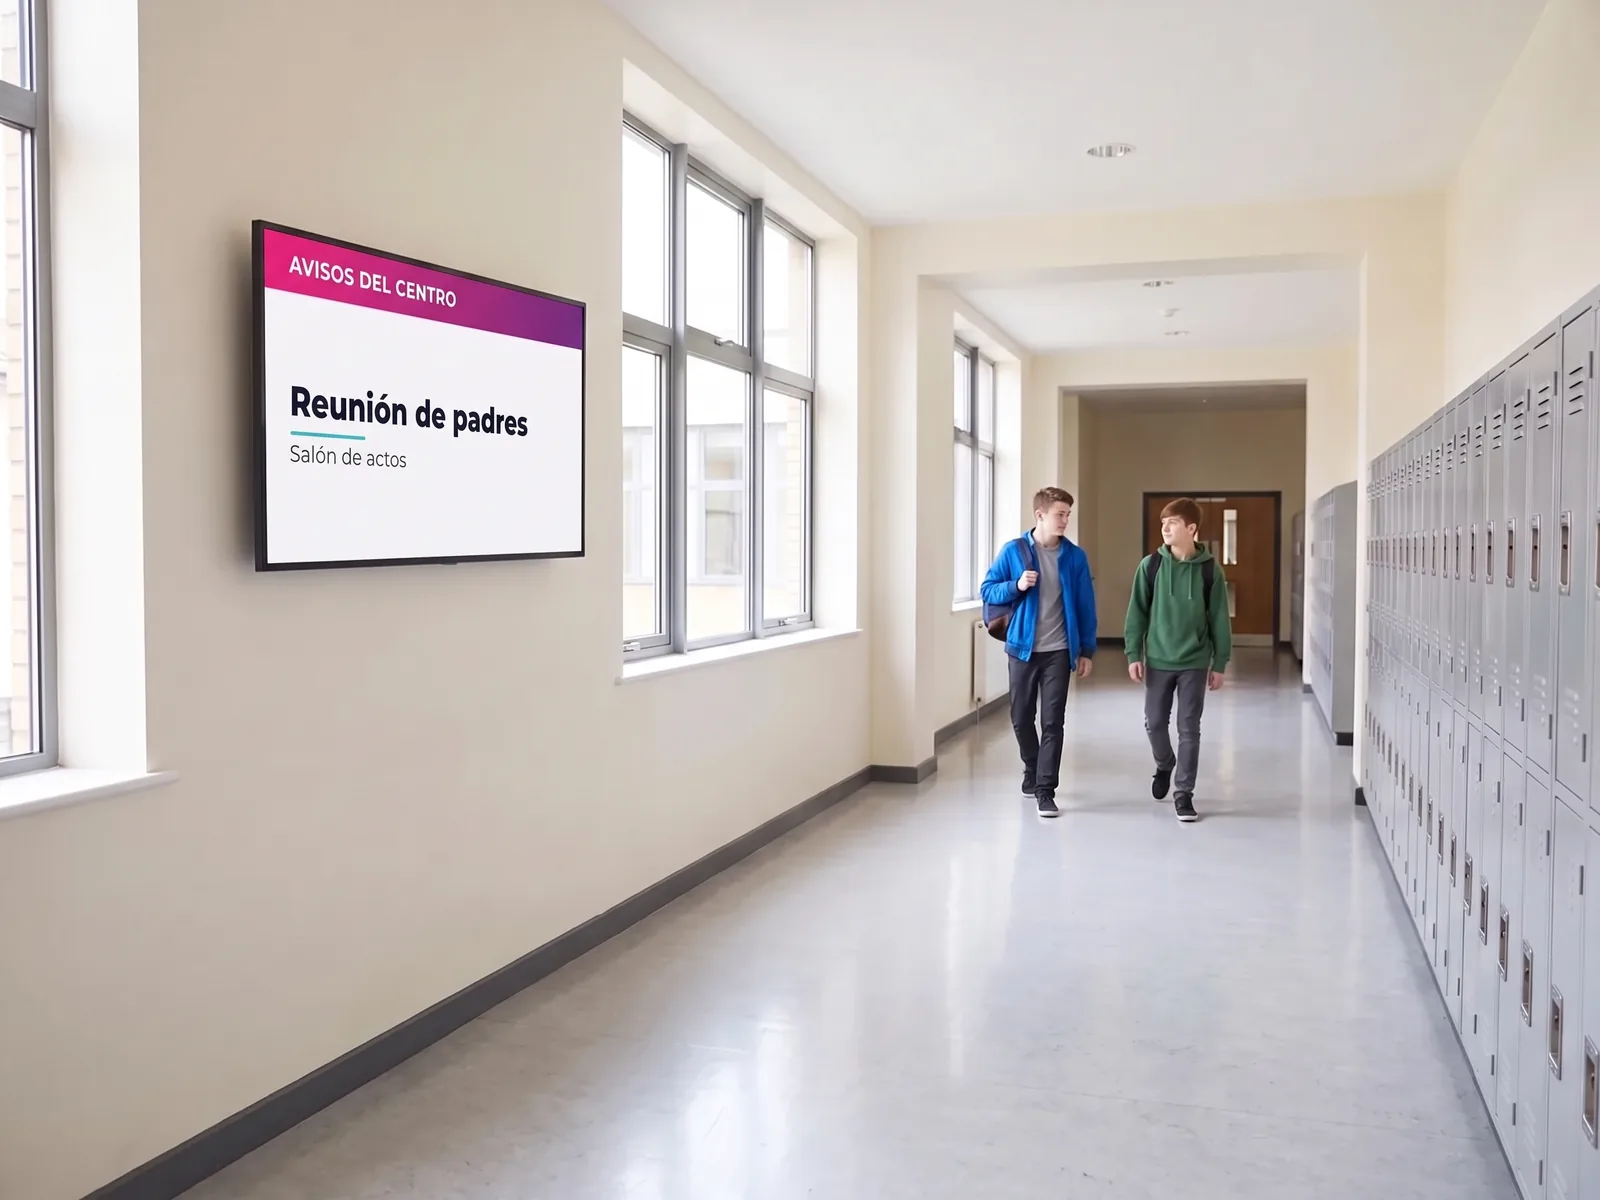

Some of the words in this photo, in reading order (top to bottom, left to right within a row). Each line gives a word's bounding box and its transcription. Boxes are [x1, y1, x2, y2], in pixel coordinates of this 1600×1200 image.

[289, 256, 354, 285] AVISOS
[360, 271, 391, 294] DEL
[396, 280, 456, 307] CENTRO
[292, 386, 407, 426] Reunión
[415, 399, 446, 429] de
[454, 406, 528, 437] padres
[290, 445, 336, 464] Salón
[342, 448, 361, 465] de
[367, 452, 406, 468] actos
